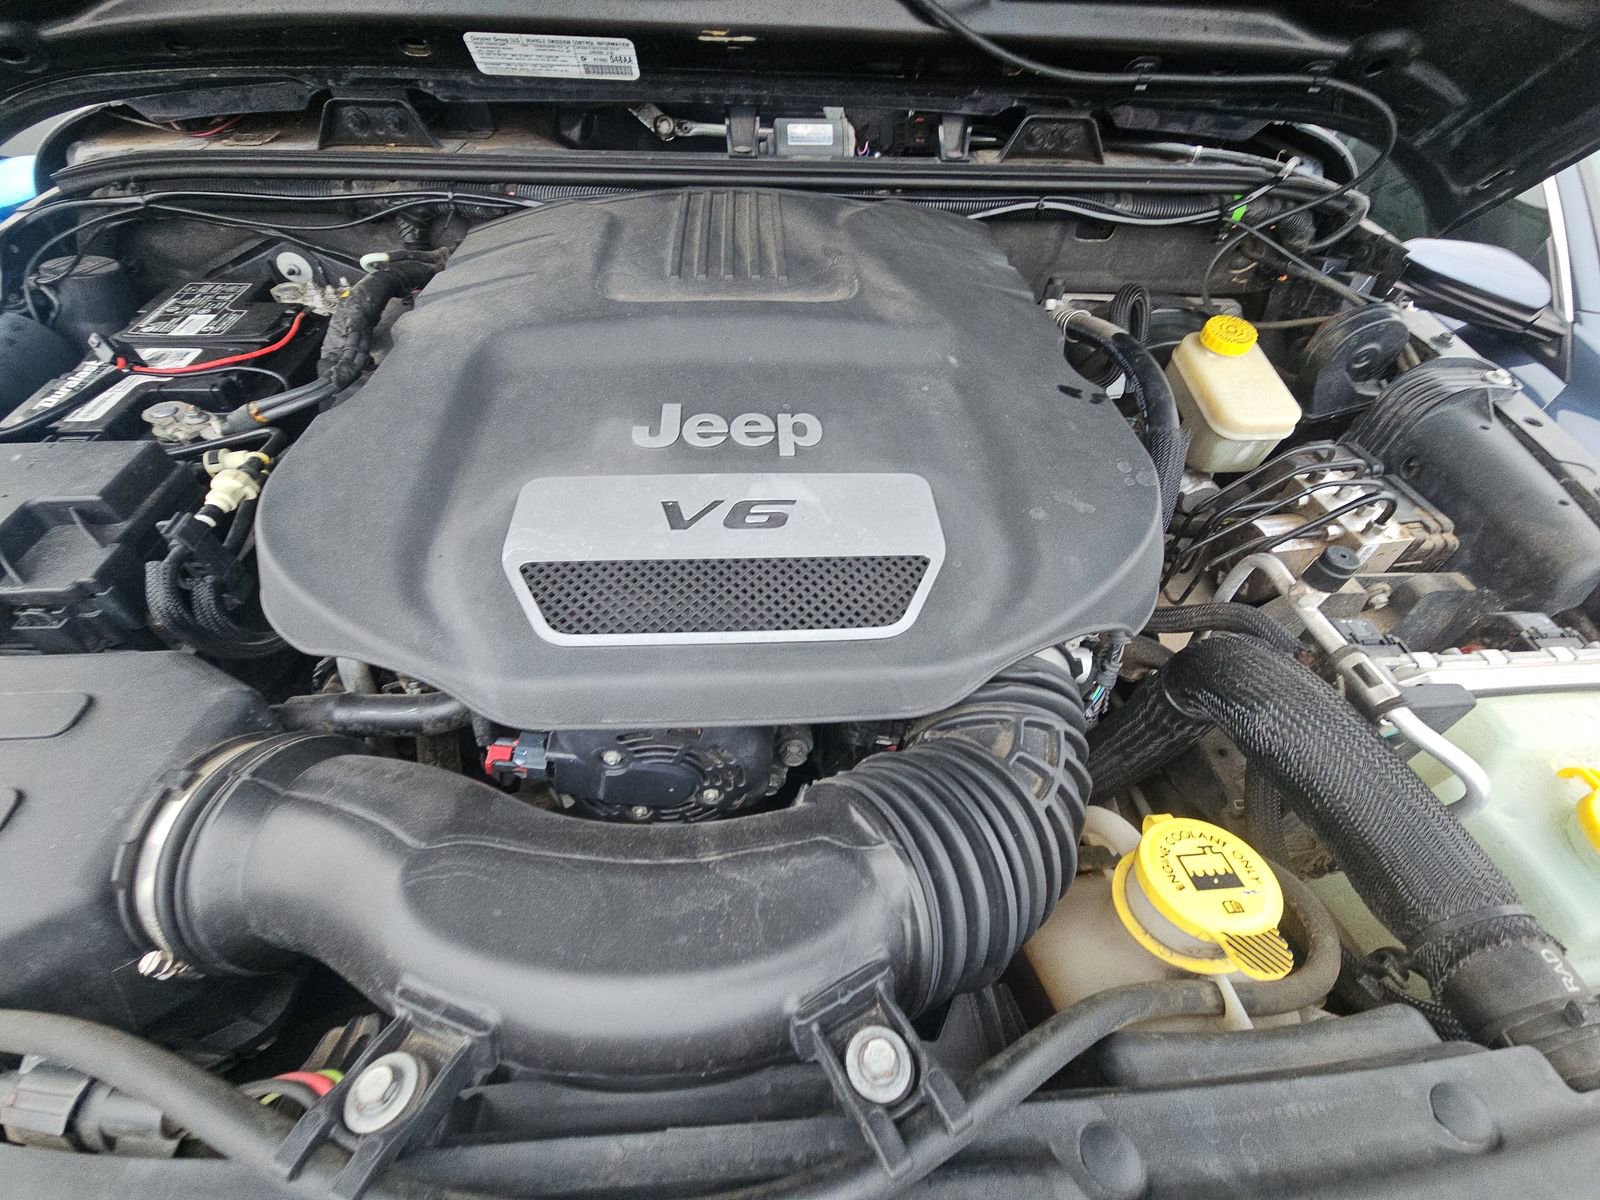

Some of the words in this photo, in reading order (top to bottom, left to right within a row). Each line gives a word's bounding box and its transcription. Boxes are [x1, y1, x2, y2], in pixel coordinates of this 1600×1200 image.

[631, 403, 823, 456] Jeep
[660, 499, 797, 531] V6
[1165, 830, 1228, 847] COOLANT
[1160, 844, 1186, 891] ENGINE
[1232, 849, 1262, 885] ONLY
